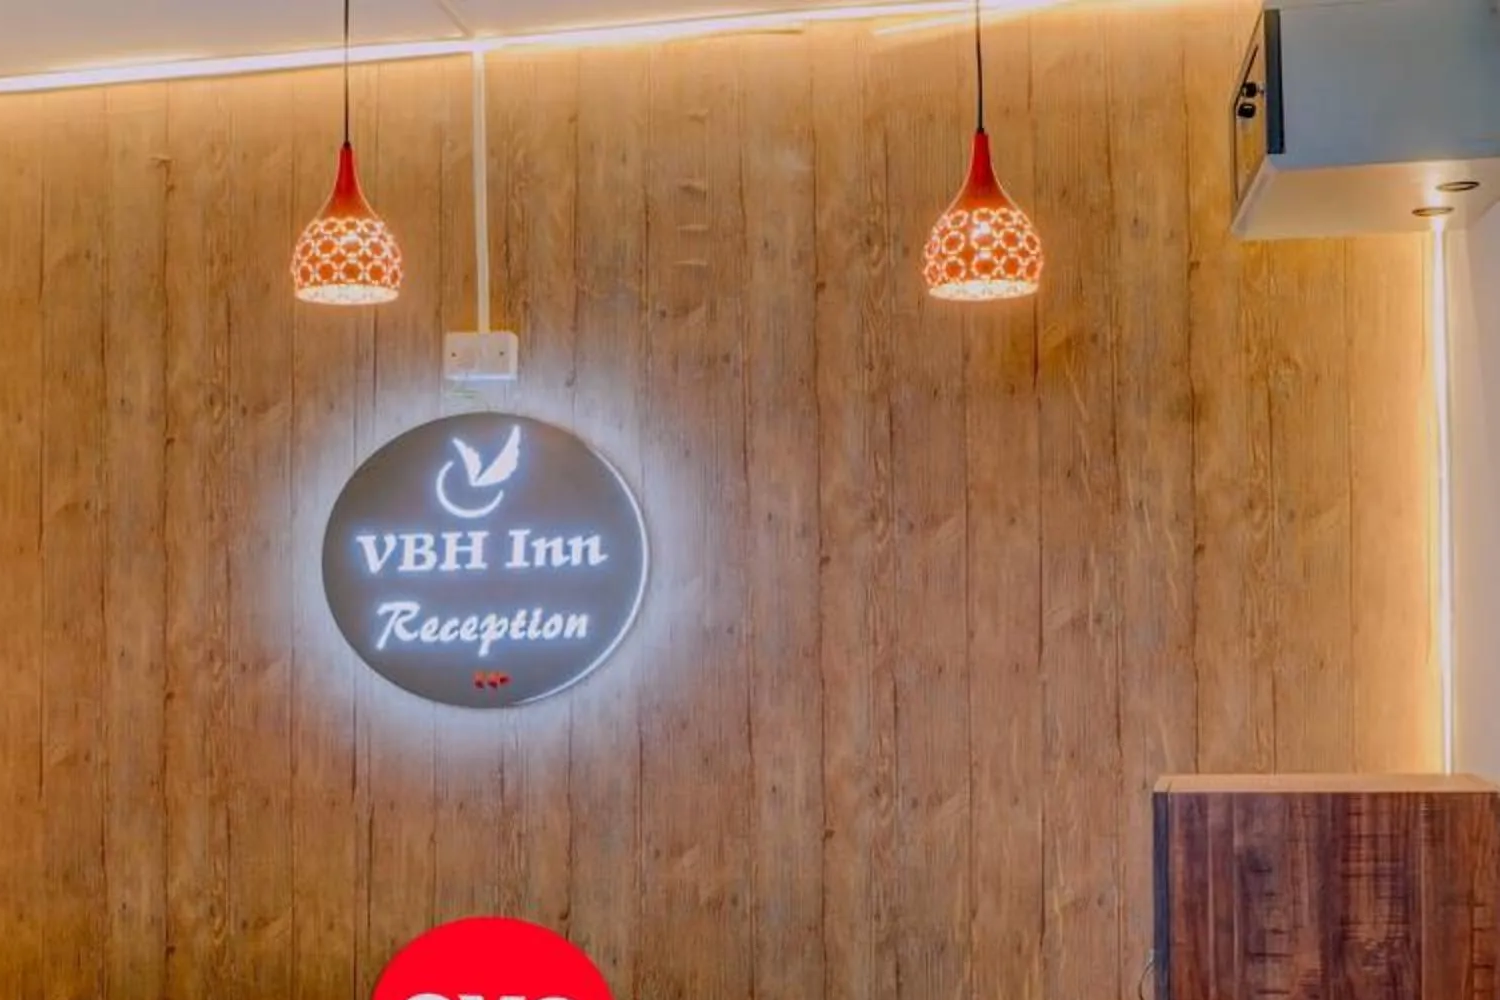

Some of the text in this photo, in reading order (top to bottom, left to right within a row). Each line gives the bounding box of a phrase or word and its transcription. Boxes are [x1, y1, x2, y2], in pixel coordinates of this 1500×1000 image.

[356, 528, 610, 575] VBH Inn
[376, 600, 590, 658] Reception
